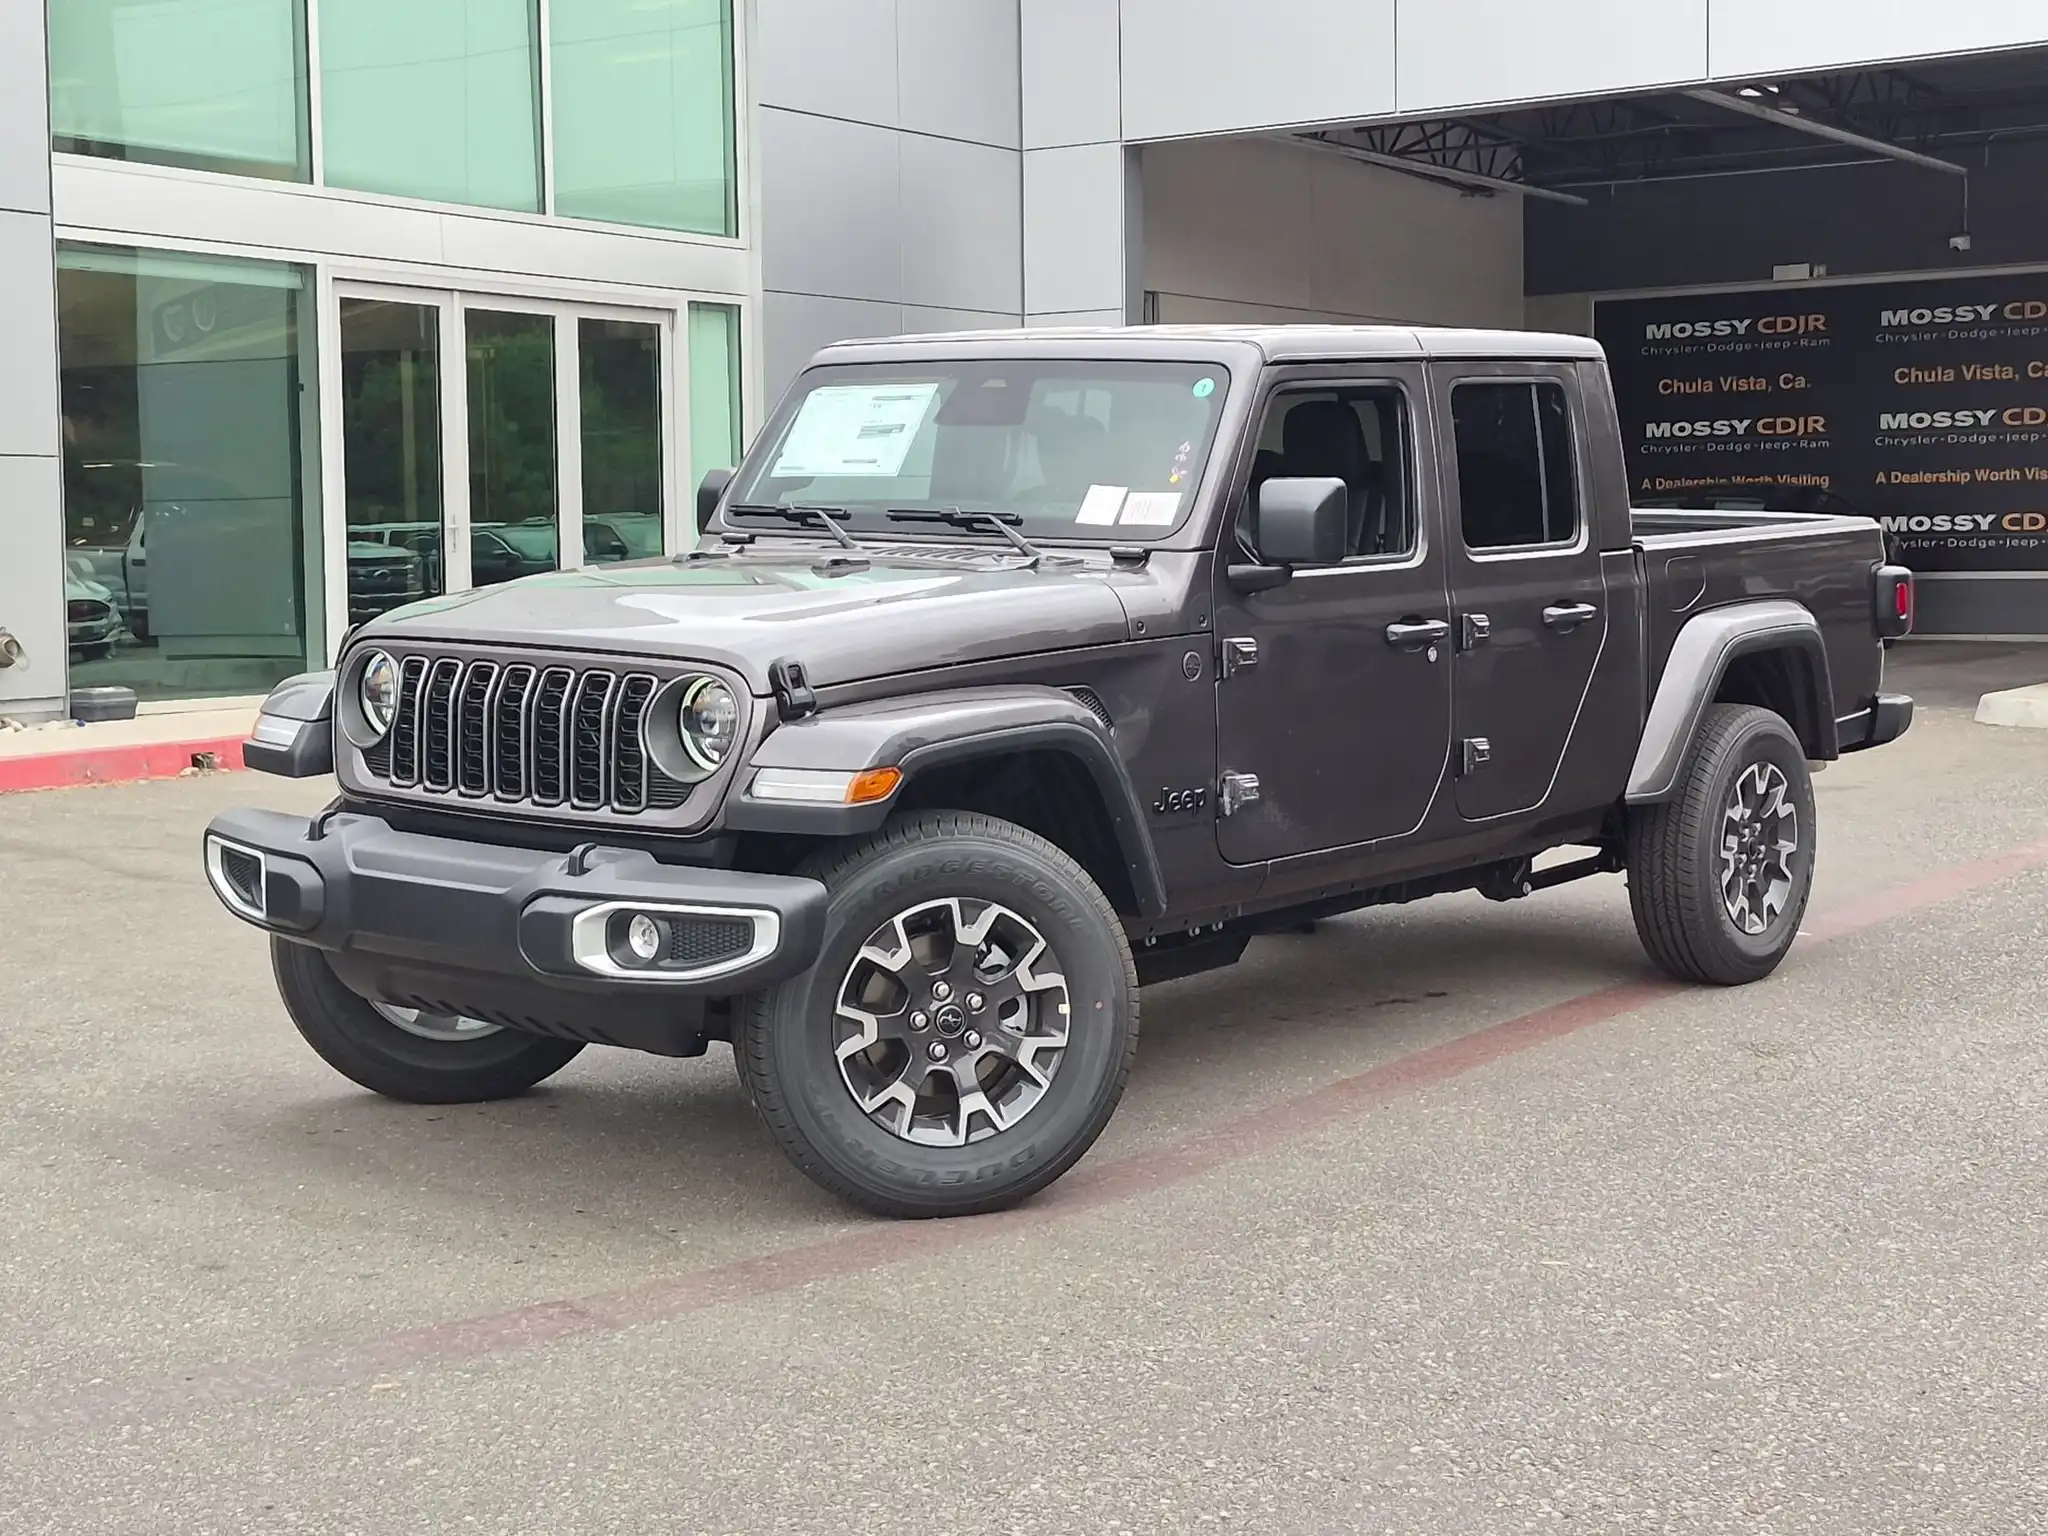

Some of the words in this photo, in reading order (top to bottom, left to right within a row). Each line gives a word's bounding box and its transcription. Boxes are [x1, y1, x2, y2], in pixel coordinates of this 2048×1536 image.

[1880, 304, 1998, 326] MOSSY
[1646, 318, 1752, 340] MOSSY
[1757, 314, 1827, 335] CDJR
[1658, 378, 1713, 395] Chula
[1719, 376, 1772, 393] Vista,
[1779, 373, 1811, 390] Ca.
[1894, 366, 1955, 384] Chula
[1961, 364, 2020, 382] Vista,
[1646, 419, 1752, 438] MOSSY
[1756, 416, 1826, 436] CDJR
[1879, 409, 1997, 430] MOSSY
[2002, 407, 2048, 427] CD
[1641, 478, 1652, 490] A
[1777, 473, 1830, 489] Visiting
[1875, 471, 1886, 484] A
[1891, 469, 1970, 485] Dealership
[1975, 467, 2020, 482] Worth
[1880, 513, 1997, 532] MOSSY
[2001, 512, 2048, 532] CD
[1152, 786, 1206, 815] Jeep
